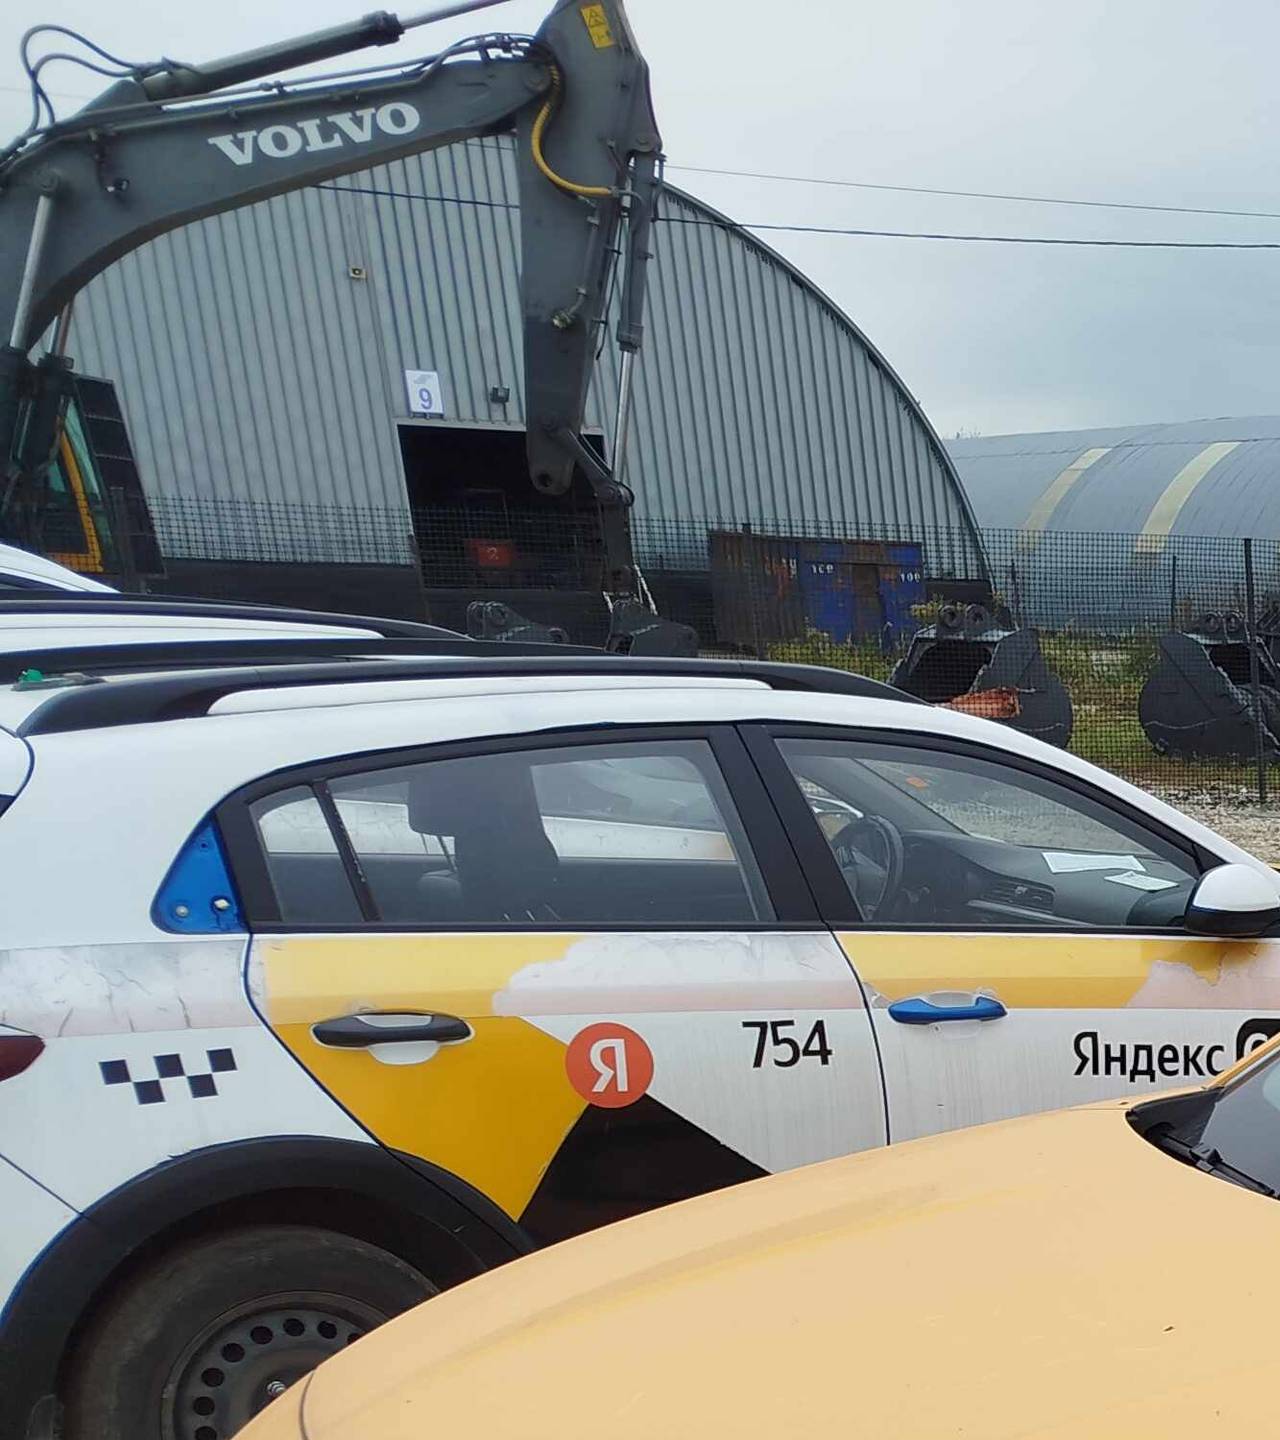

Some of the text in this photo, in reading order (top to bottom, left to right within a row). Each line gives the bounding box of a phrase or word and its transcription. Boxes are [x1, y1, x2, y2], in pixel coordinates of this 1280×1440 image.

[208, 102, 420, 166] VOLVO
[418, 387, 433, 410] 9
[589, 1038, 629, 1093] Я
[742, 1019, 833, 1068] 754
[1073, 1031, 1225, 1083] Яндекс
